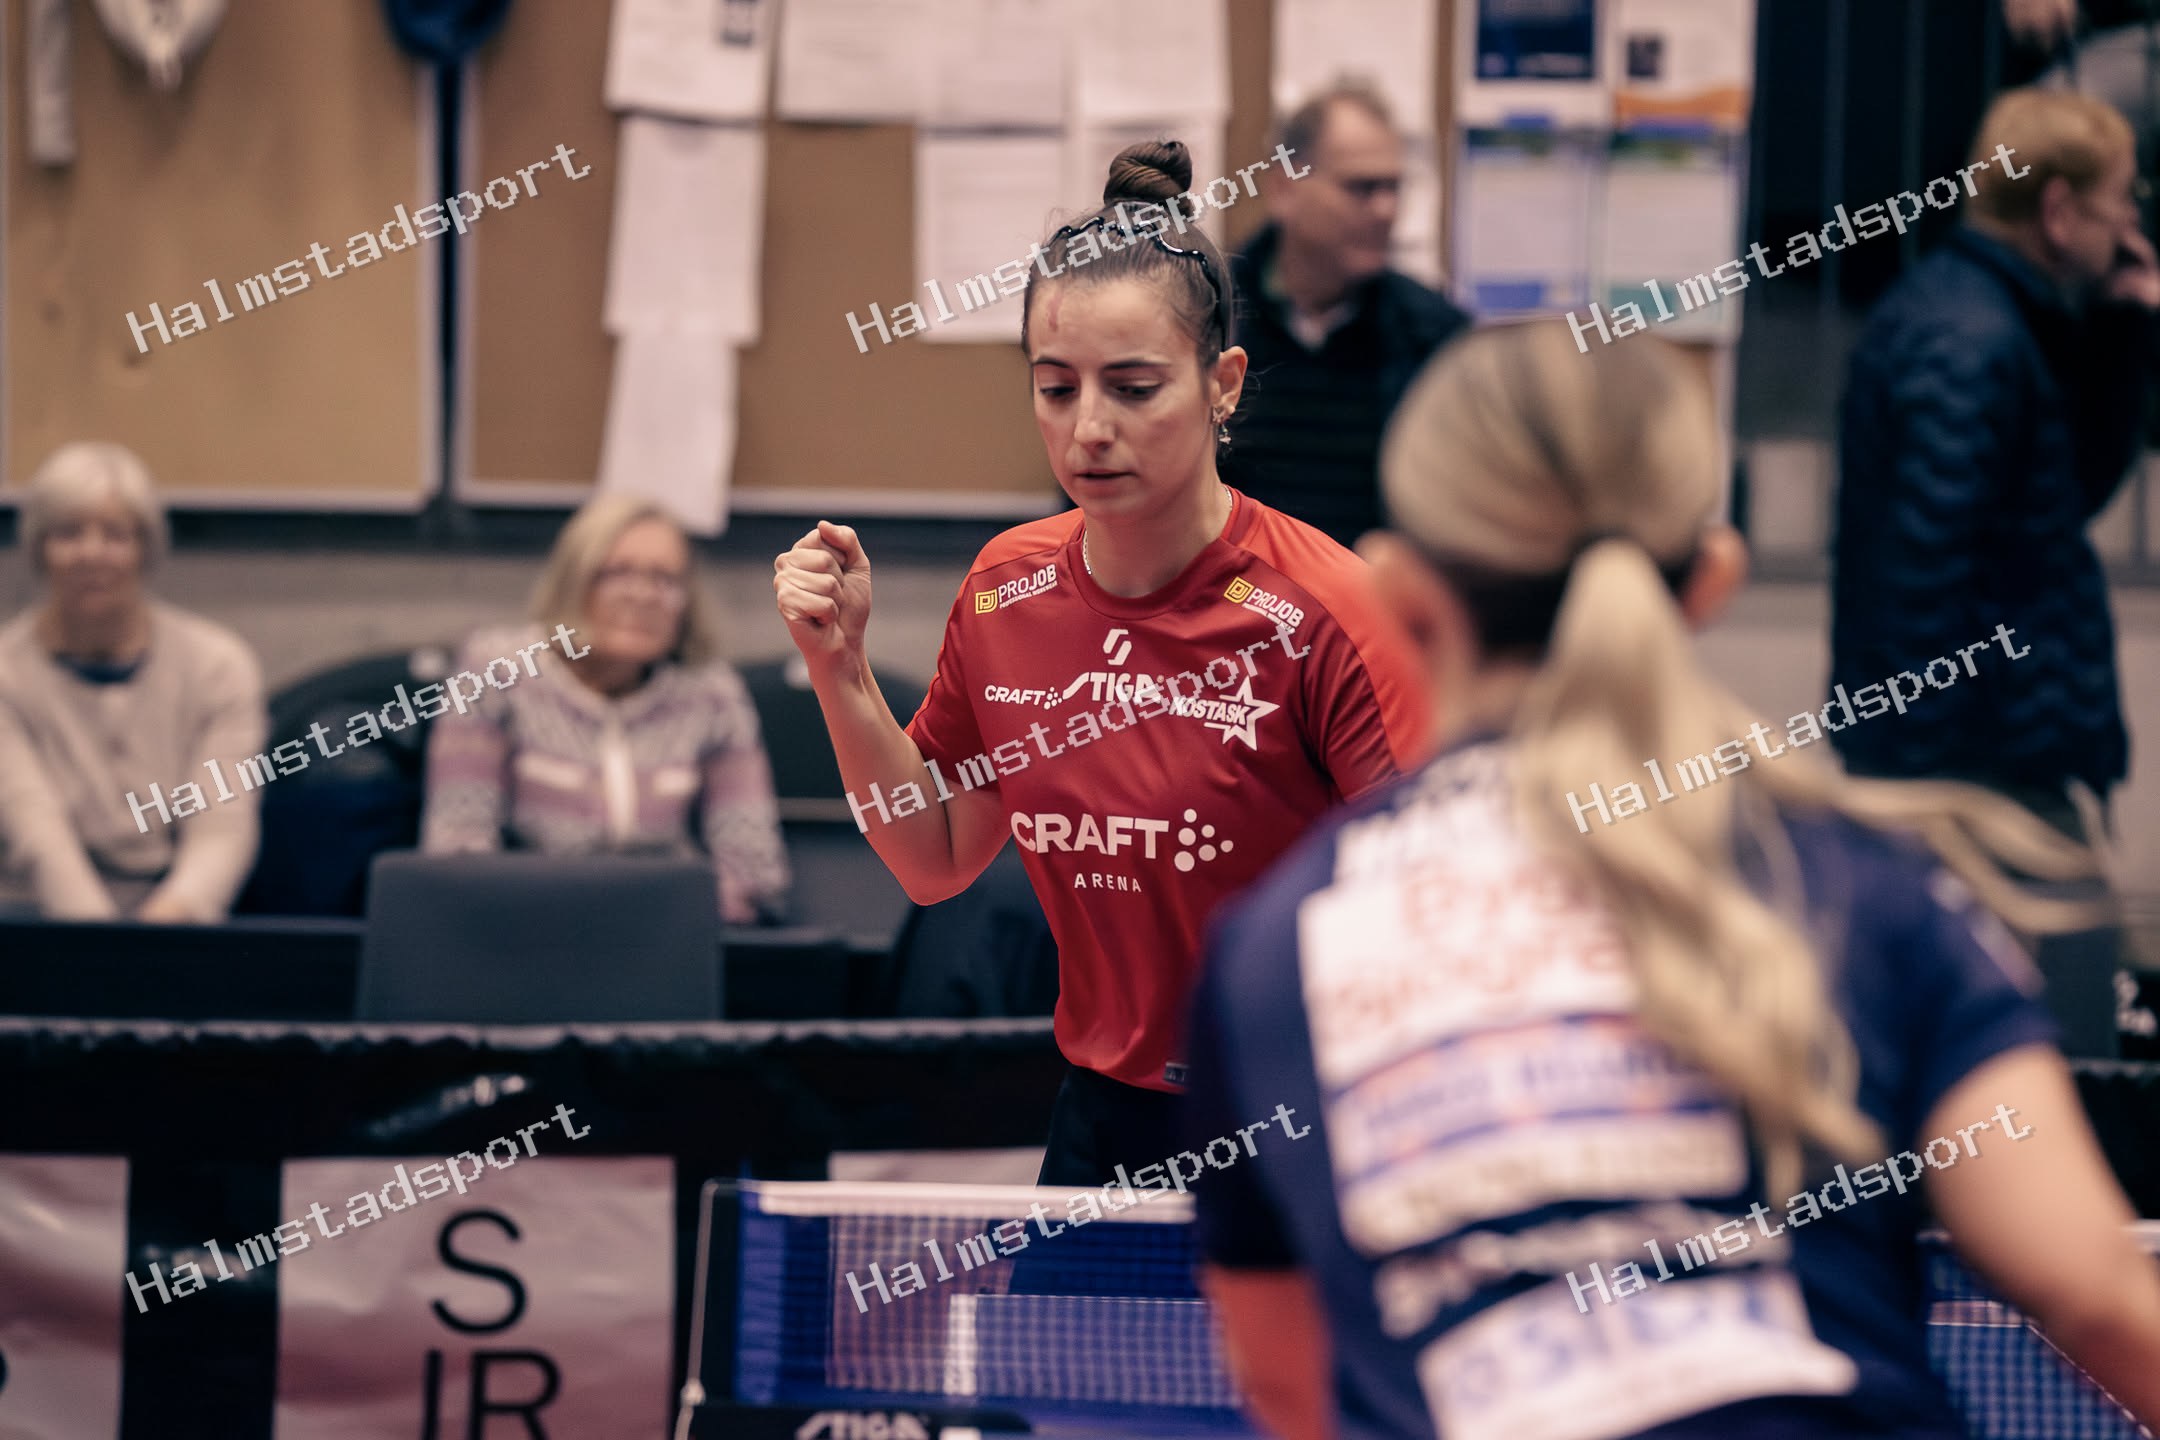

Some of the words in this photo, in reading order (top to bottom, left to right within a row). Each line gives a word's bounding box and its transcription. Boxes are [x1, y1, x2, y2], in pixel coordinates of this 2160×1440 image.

[998, 564, 1056, 602] PROJOB
[1246, 587, 1304, 628] PROJOB
[984, 685, 1045, 706] CRAFT
[1063, 672, 1161, 702] STIGA
[1011, 811, 1169, 859] CRAFT
[1074, 873, 1141, 892] ARENA
[433, 1209, 525, 1333] S
